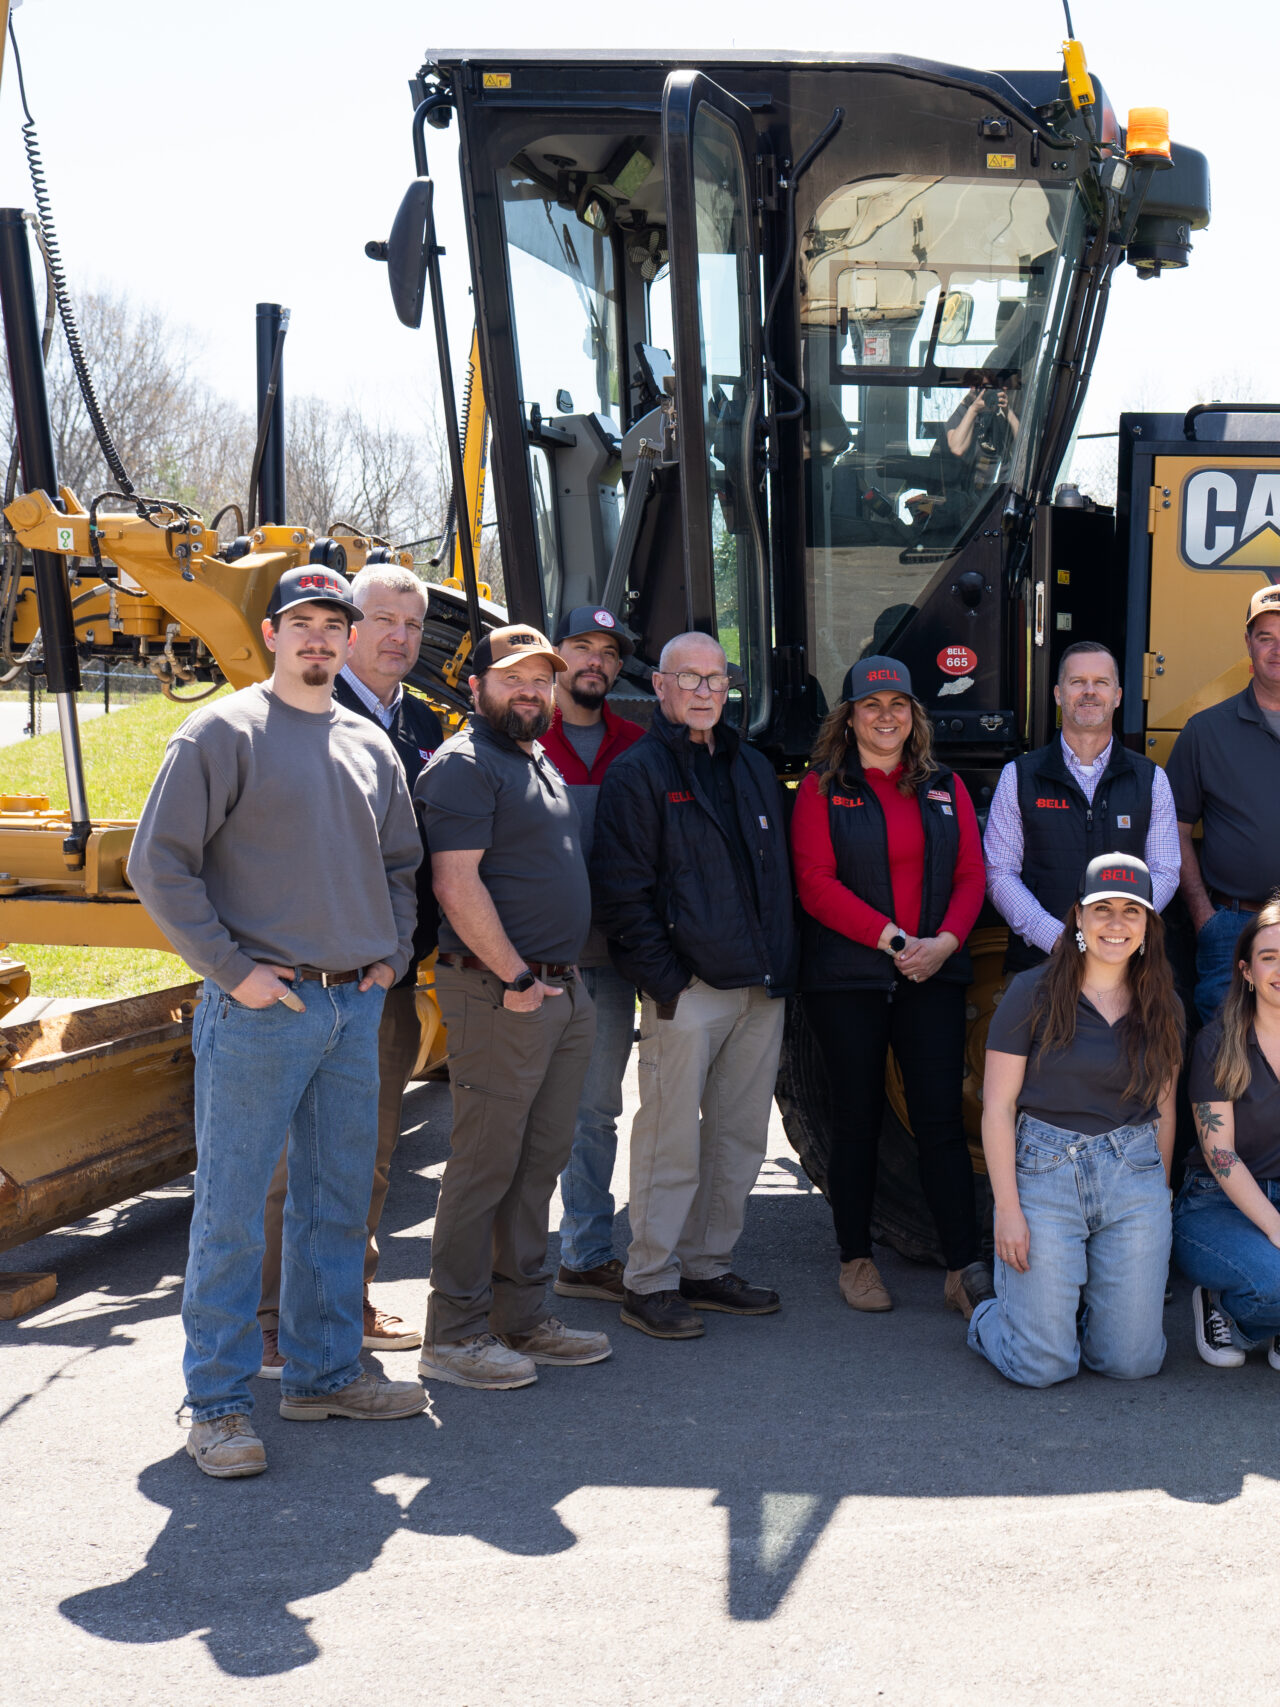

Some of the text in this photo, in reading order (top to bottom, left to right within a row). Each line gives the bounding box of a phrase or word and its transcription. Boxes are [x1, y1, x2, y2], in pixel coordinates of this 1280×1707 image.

[298, 575, 343, 594] BELL
[508, 633, 546, 649] BELL
[947, 647, 968, 655] BELL
[946, 657, 968, 667] 665
[866, 669, 901, 682] BELL
[832, 796, 864, 808] BELL
[1035, 798, 1069, 809] BELL
[1100, 868, 1138, 884] BELL
